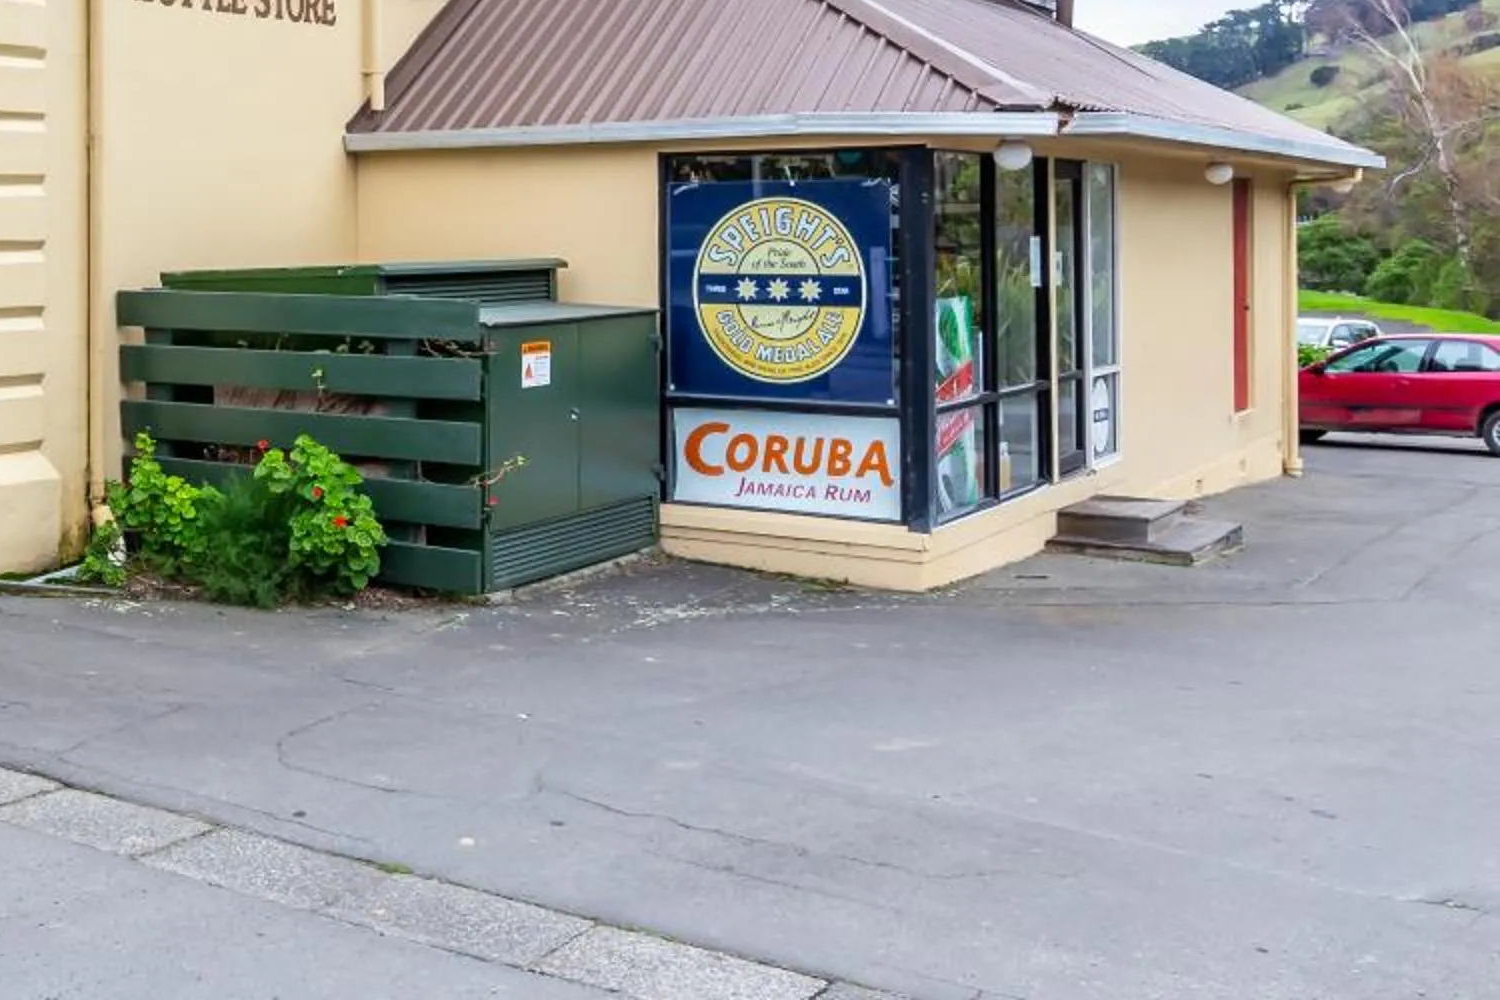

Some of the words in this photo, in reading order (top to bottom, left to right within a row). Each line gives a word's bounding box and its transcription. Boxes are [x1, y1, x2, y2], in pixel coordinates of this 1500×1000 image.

[683, 420, 894, 487] CORUBA
[735, 476, 817, 498] JAMAICA
[824, 485, 872, 504] RUM
